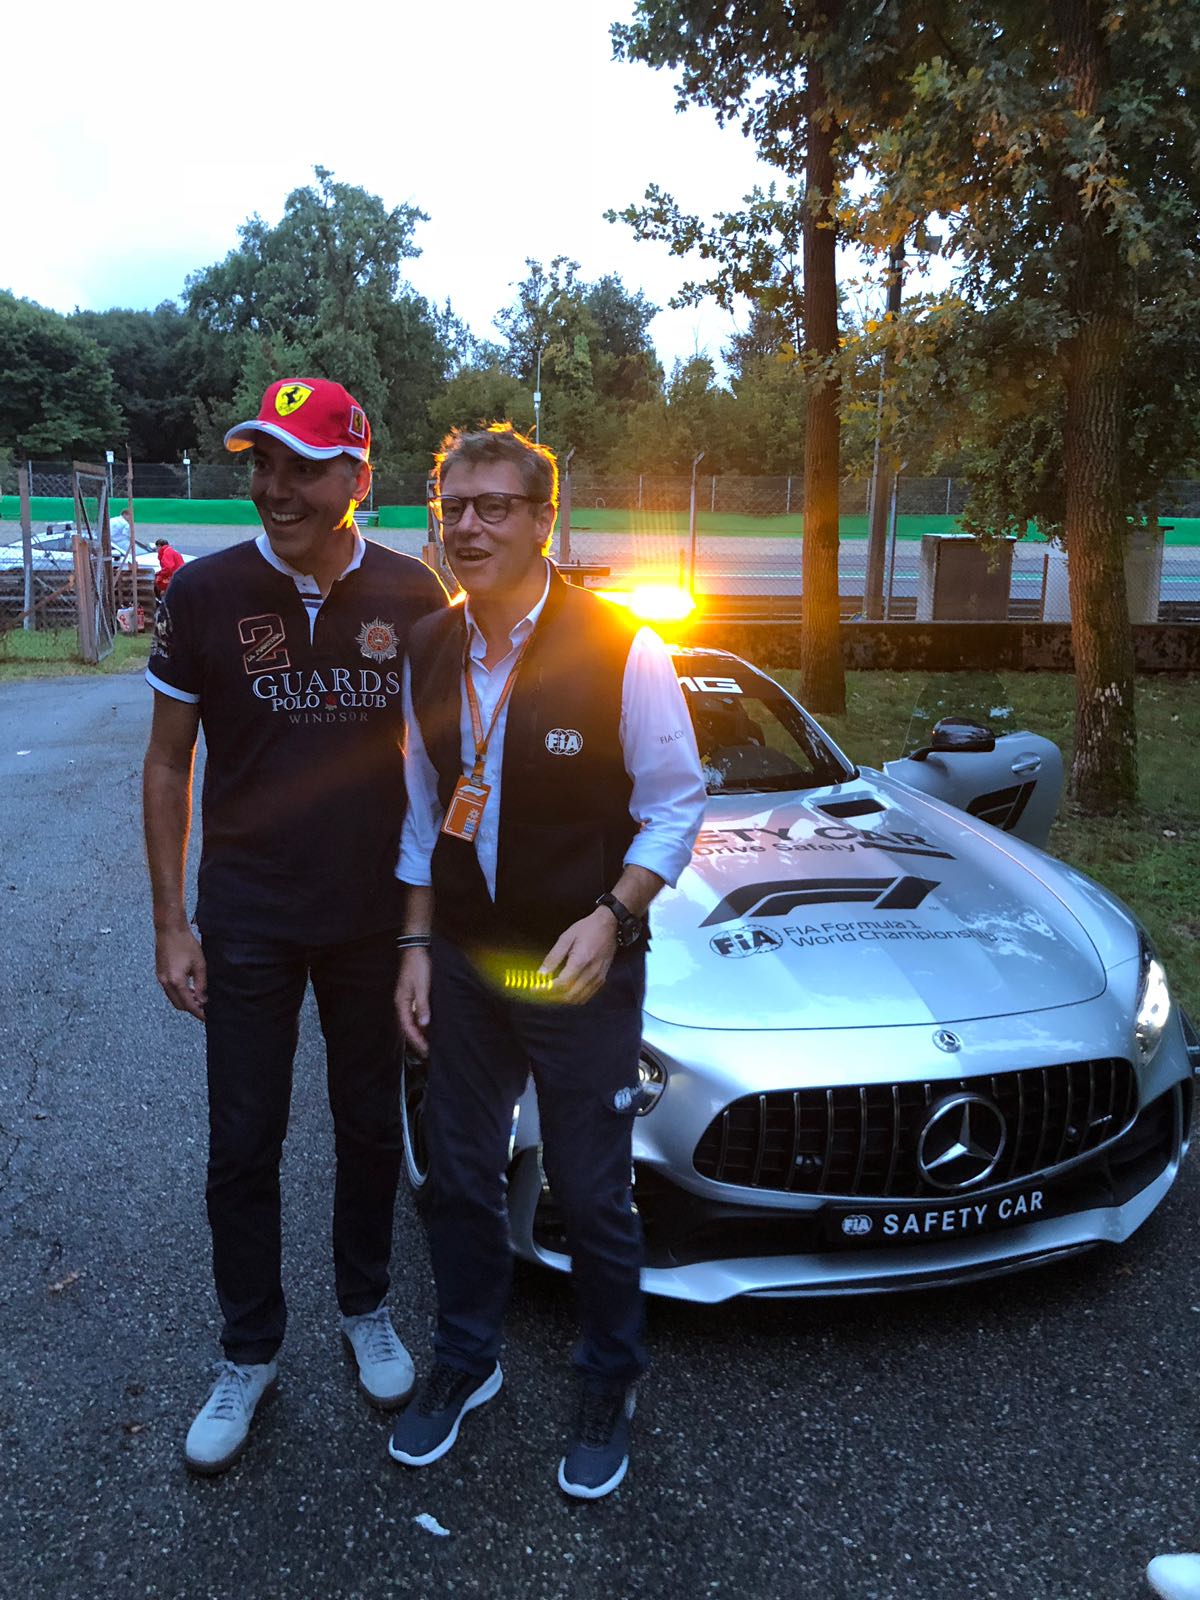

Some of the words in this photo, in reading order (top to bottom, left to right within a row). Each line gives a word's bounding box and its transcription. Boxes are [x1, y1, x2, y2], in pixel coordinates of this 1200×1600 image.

[252, 667, 400, 700] GUARDS
[271, 694, 320, 712] POLO
[340, 692, 387, 708] CLUB
[288, 711, 369, 725] WINDSOR
[814, 826, 937, 849] CAR
[693, 845, 766, 856] Drive
[772, 842, 856, 853] Safely
[783, 924, 820, 936] FIA
[821, 920, 906, 932] Formula
[790, 931, 857, 947] World
[860, 929, 998, 942] Championship
[883, 1204, 988, 1235] SAFETY
[998, 1191, 1043, 1219] CAR
